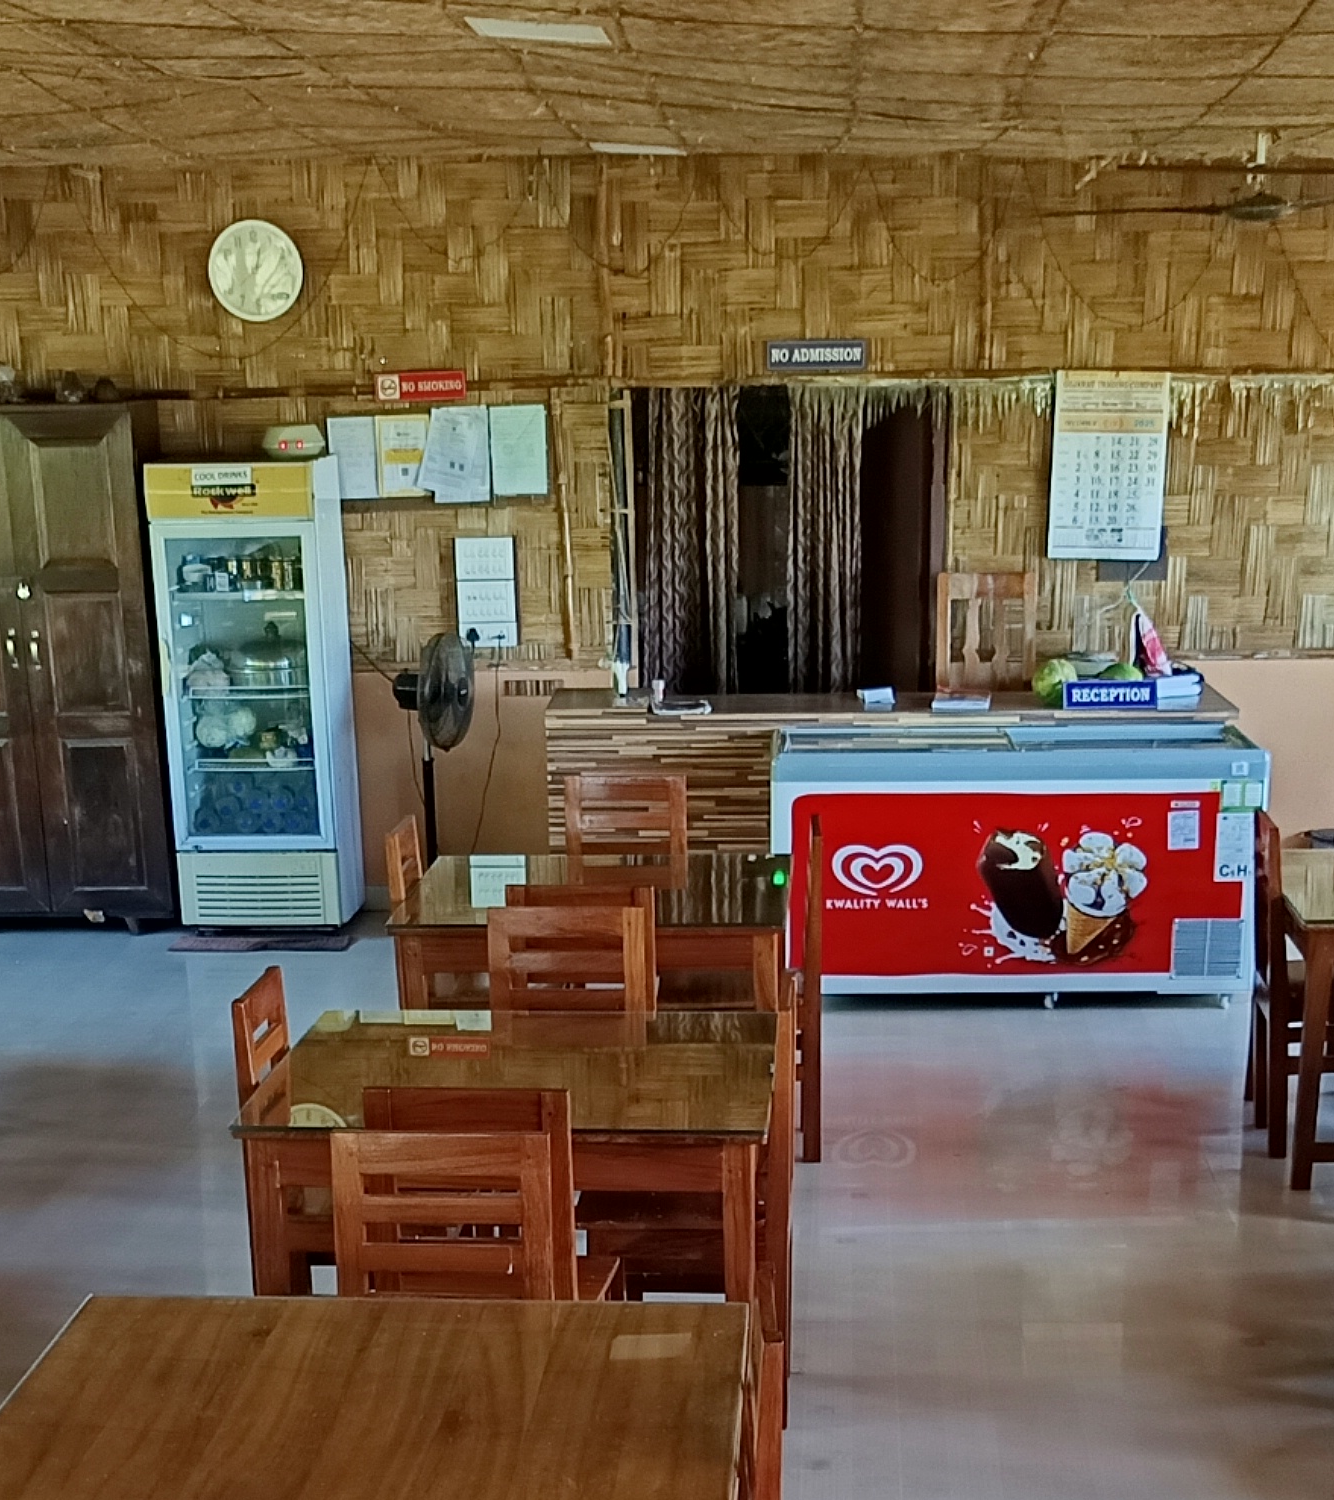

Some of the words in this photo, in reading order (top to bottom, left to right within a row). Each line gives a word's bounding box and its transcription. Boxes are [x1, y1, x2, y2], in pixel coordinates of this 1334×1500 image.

[771, 348, 789, 363] NO
[792, 347, 862, 363] ADMISSION
[401, 381, 415, 393] NO
[417, 380, 463, 393] SMOKING
[194, 472, 215, 481] COOL
[217, 470, 248, 480] DRINKS
[1071, 687, 1151, 703] RECEPTION
[825, 898, 881, 910] KWALITY
[885, 897, 929, 910] WALL'S
